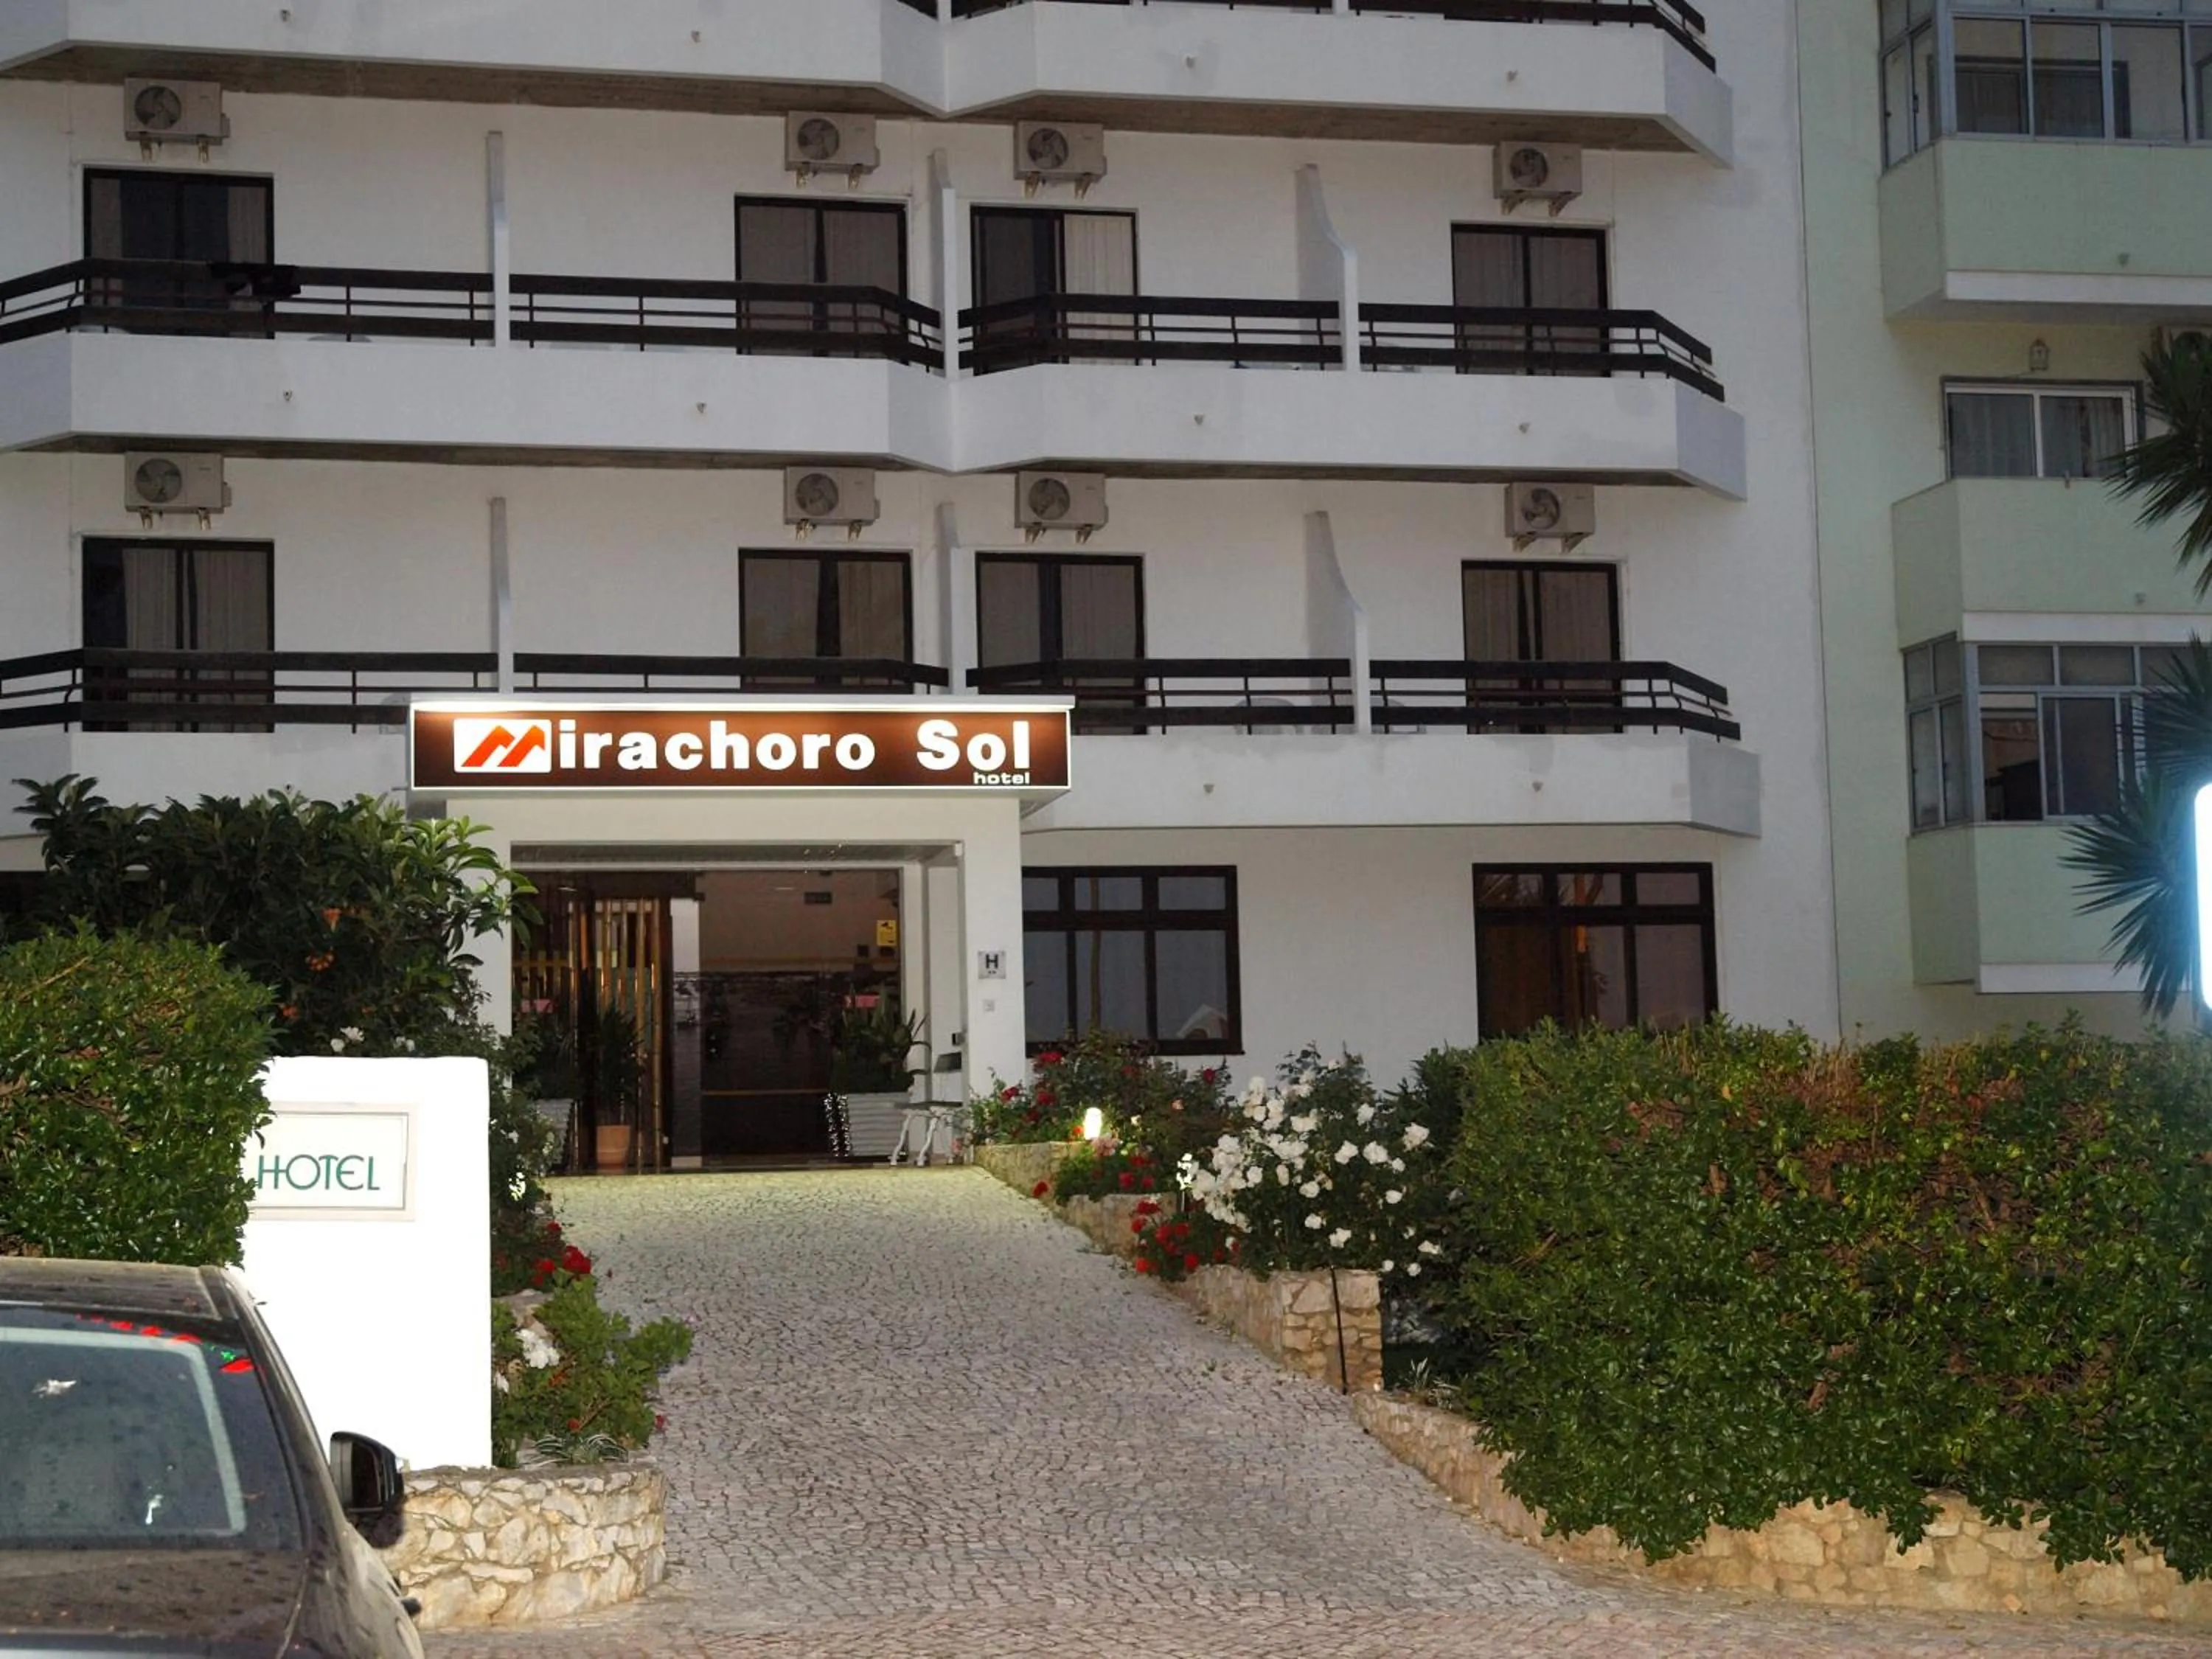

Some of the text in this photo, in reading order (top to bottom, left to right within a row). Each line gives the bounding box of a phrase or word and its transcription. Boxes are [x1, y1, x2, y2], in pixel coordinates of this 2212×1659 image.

[917, 719, 1031, 771] Sol
[973, 771, 1031, 785] hotel
[985, 953, 998, 969] H
[257, 1154, 380, 1190] HOTEL
